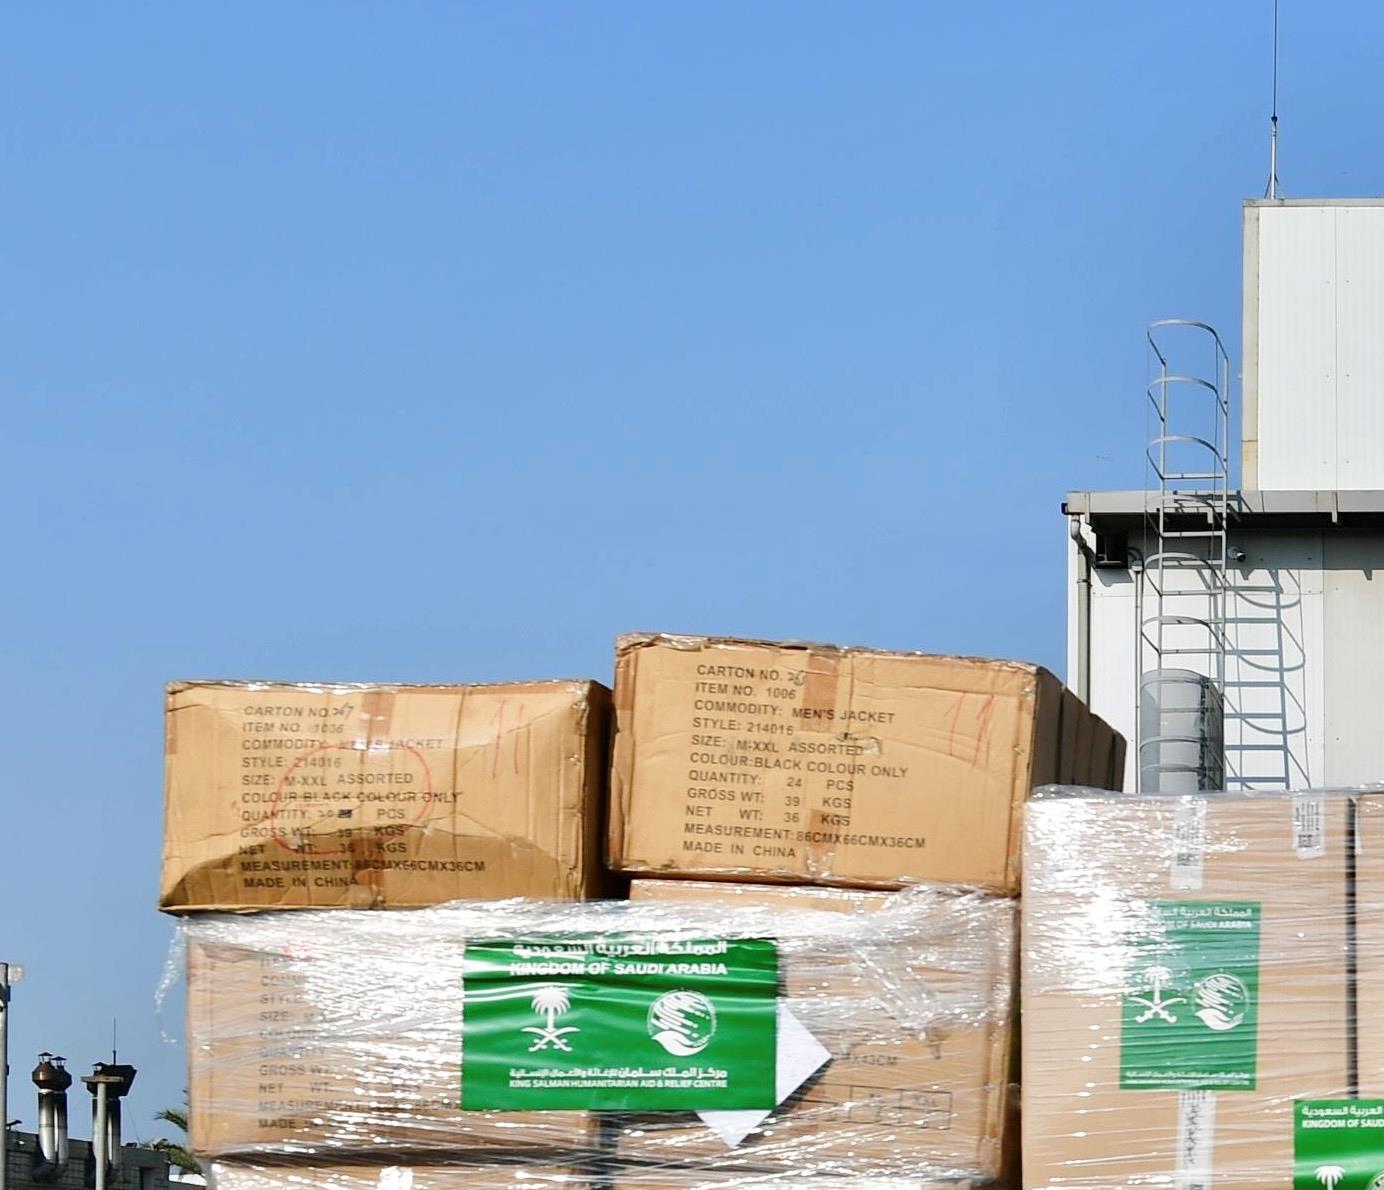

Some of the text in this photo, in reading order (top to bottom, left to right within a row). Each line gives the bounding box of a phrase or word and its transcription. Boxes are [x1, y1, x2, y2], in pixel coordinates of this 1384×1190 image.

[696, 664, 755, 679] CARTON
[760, 669, 782, 681] NO.
[695, 682, 796, 700] ITEM NO. 1006
[244, 705, 303, 718] CARTON
[694, 700, 895, 724] COMMODITY: MEN'S JACKET
[242, 722, 275, 733] ITEM
[692, 717, 794, 736] STYLE: 214016
[690, 734, 864, 756] SIZE: M-XXL ASSORTED
[242, 757, 342, 768] STYLE: 214016
[807, 761, 866, 776] COLOUR
[871, 765, 908, 779] ONLY
[242, 773, 413, 787] SIZE: M-XXL ASSORTED
[688, 769, 854, 792] QUANTITY: 24 PCS
[356, 791, 417, 803] COLOUR
[421, 791, 464, 803] ONLY
[687, 788, 852, 810] GROSS WT: 39 KGS
[242, 809, 312, 822] QUANTITY:
[377, 808, 405, 820] PCS
[685, 805, 851, 828] NET WT: 36 KGS
[240, 826, 287, 838] GROSS
[337, 828, 351, 838] 39
[374, 826, 405, 838] KGS
[239, 845, 265, 856] NET
[376, 843, 408, 854] KGS
[682, 840, 796, 859] MADE IN CHINA
[244, 876, 359, 889] MADE IN CHINA
[595, 941, 655, 958] العربية
[655, 940, 728, 956] المملكة
[509, 963, 728, 976] KINGDOM OF SAUDI ARABIA
[509, 1079, 728, 1088] KING SALMAN HUMANITARIAN AID & RELIEF CENTRE
[1302, 1106, 1348, 1118] السعودية
[1349, 1105, 1383, 1118] العربية
[1302, 1119, 1346, 1129] KINGDOM
[1347, 1119, 1360, 1128] OF
